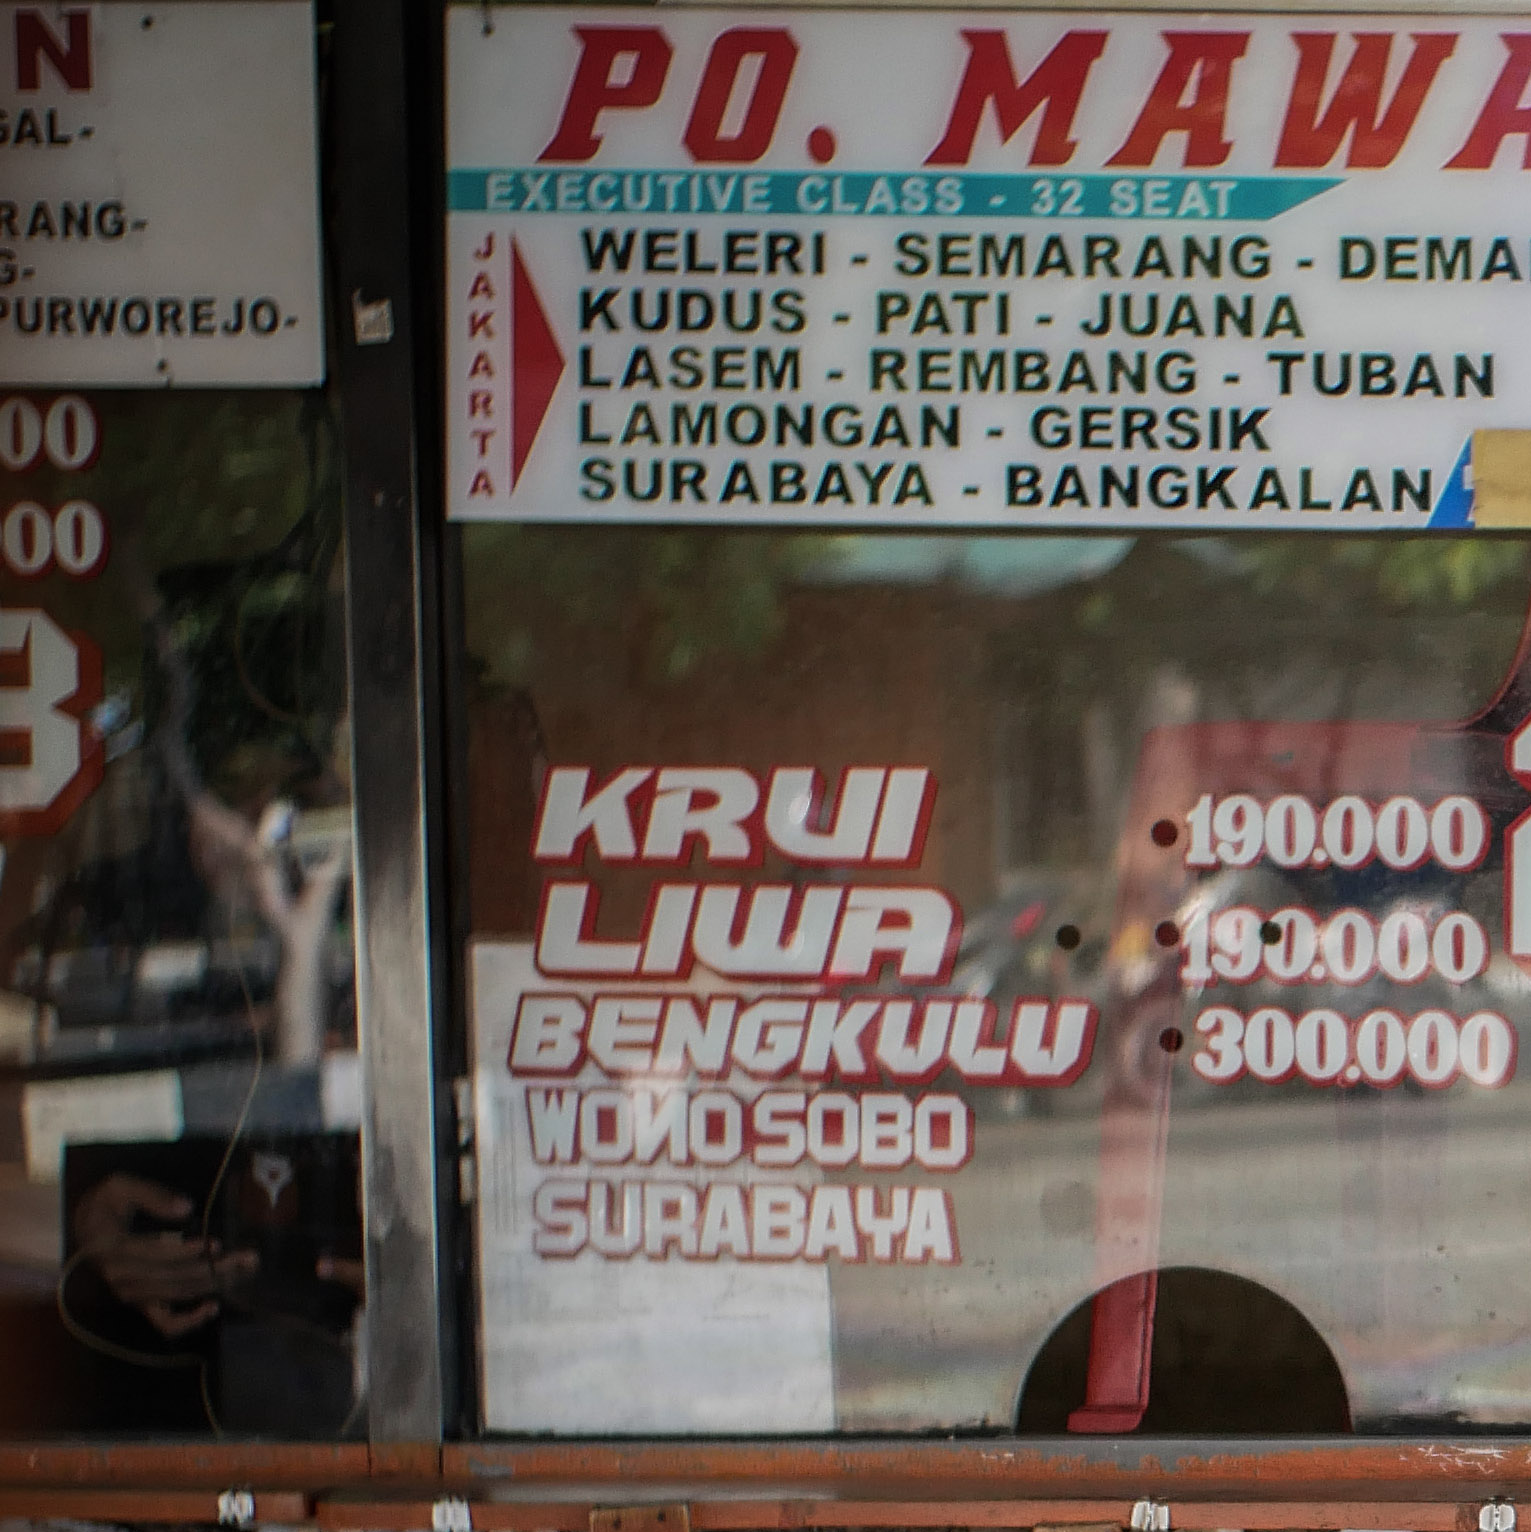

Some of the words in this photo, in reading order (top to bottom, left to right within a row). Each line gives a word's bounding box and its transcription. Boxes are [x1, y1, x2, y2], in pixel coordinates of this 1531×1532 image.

[534, 23, 838, 165] PO.
[486, 174, 773, 214] EXECUTIVE
[796, 175, 966, 216] CLASS
[1030, 179, 1085, 217] 32
[1110, 179, 1239, 219] SEAT
[581, 229, 826, 276] WELERI
[893, 231, 1271, 281] SEMARANG
[577, 288, 809, 334] KUDUS
[875, 291, 1011, 336] PATI
[1080, 293, 1305, 340] JUANA
[467, 231, 497, 499] JAKARTA
[577, 346, 802, 391] LASEM
[869, 349, 1197, 396] REMBANG
[1266, 351, 1496, 399] TUBAN
[577, 402, 962, 449] LAMONGAN
[1030, 405, 1271, 453] GERSIK
[577, 459, 935, 504] SURABAYA
[1005, 462, 1433, 513] BANGKALAN
[531, 765, 938, 868] KRUI
[1185, 793, 1491, 872] 190.000
[533, 880, 963, 985] LIWA
[1181, 906, 1490, 985] 190.000
[507, 993, 1098, 1087] BENGKULU
[1192, 1006, 1519, 1089] 300.000
[533, 1178, 961, 1265] SURABAYA
